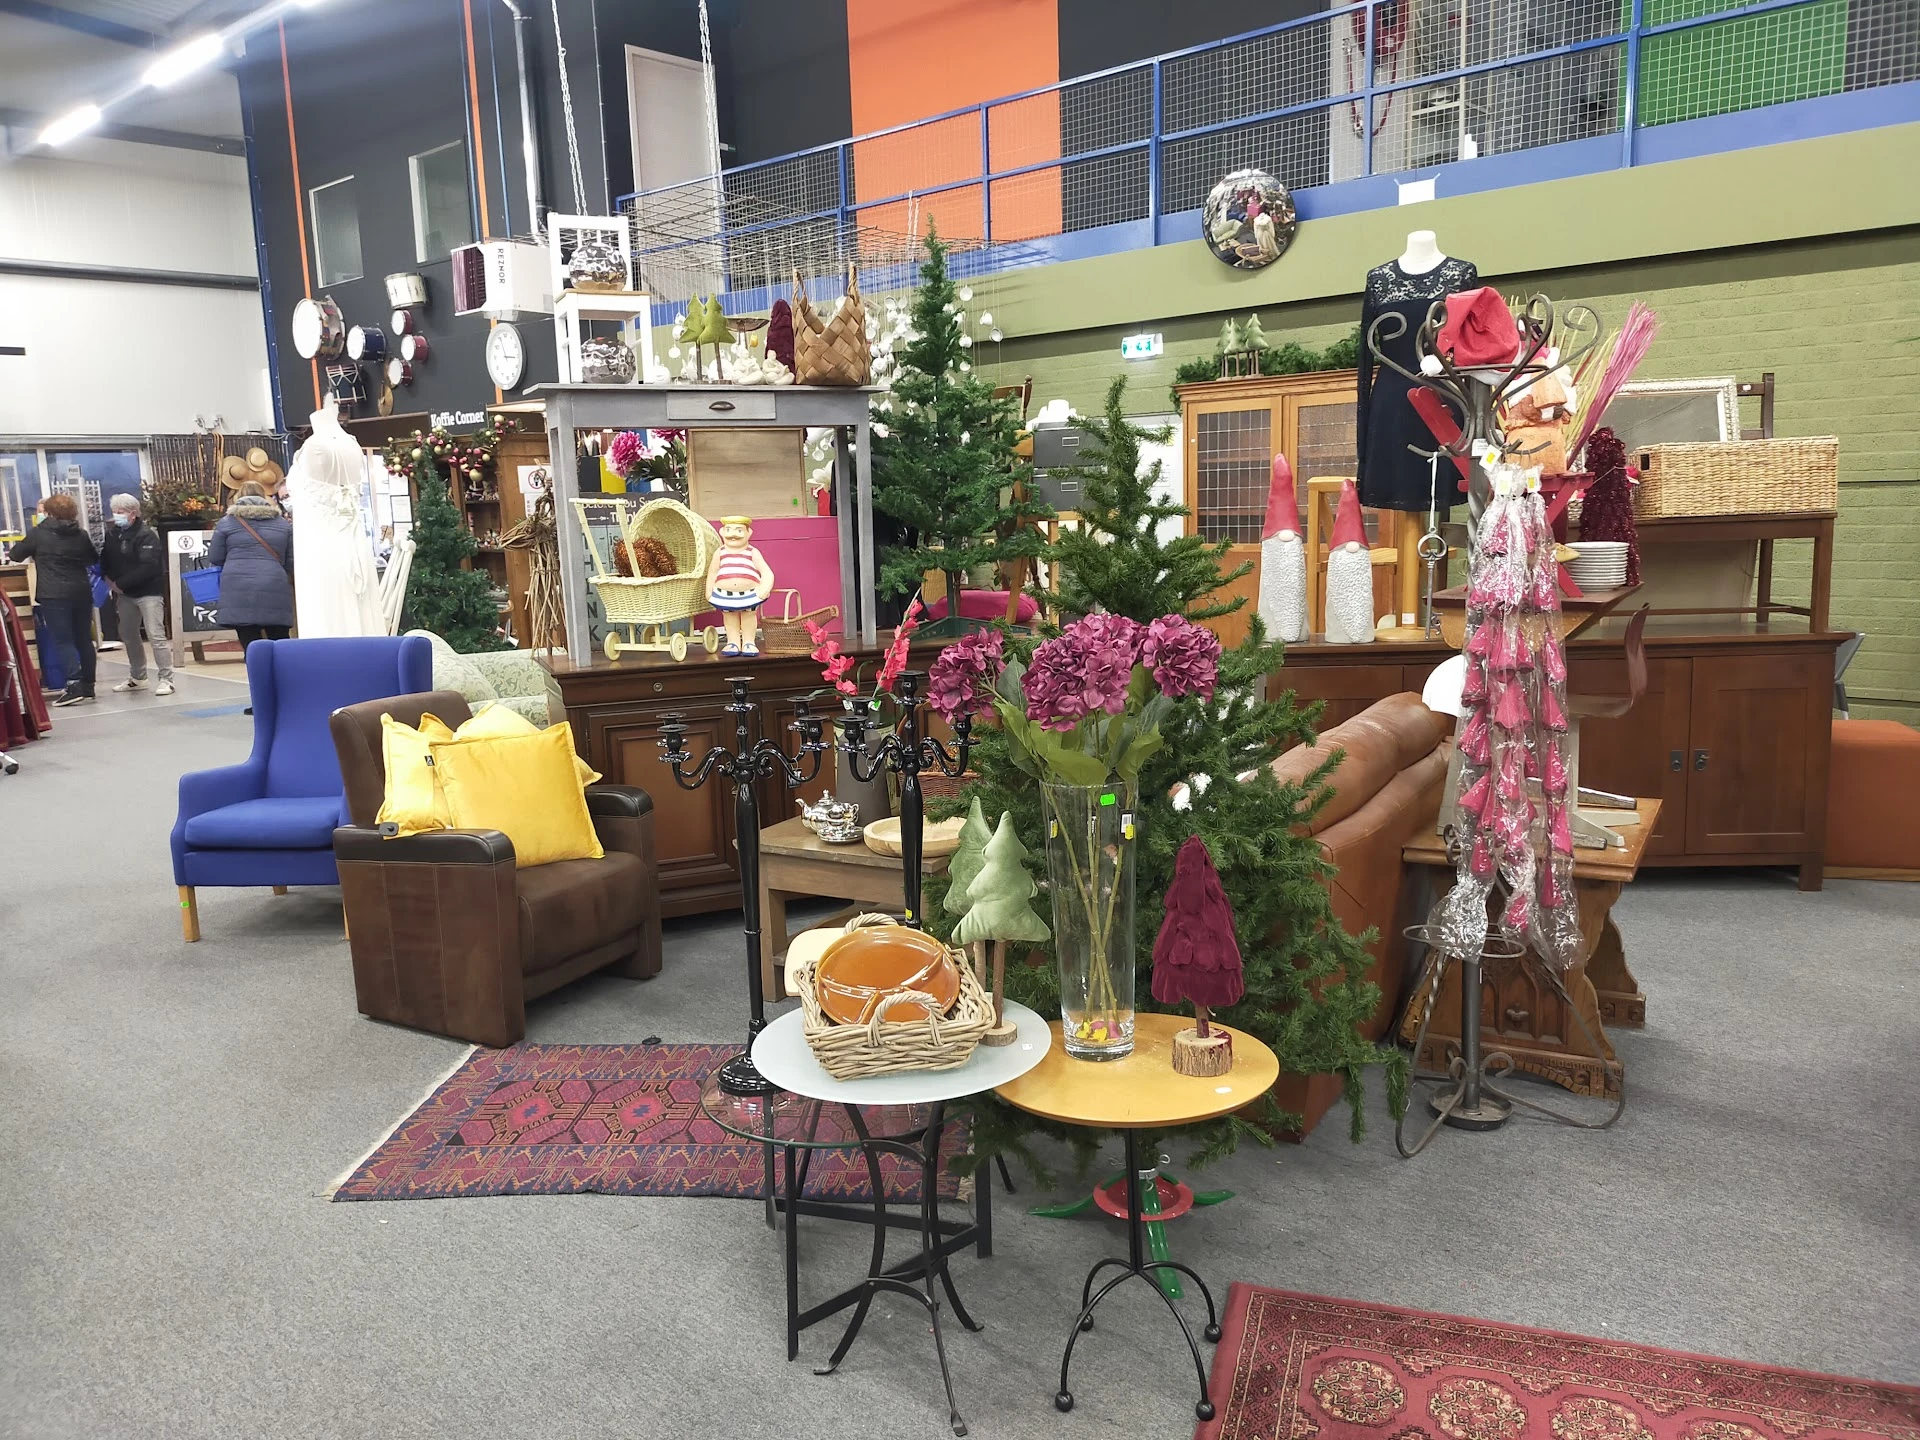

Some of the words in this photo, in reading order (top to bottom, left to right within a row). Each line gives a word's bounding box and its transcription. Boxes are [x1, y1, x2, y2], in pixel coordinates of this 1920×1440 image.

[497, 248, 506, 284] REZNOR
[430, 411, 455, 428] Koffie
[455, 410, 485, 425] Corner
